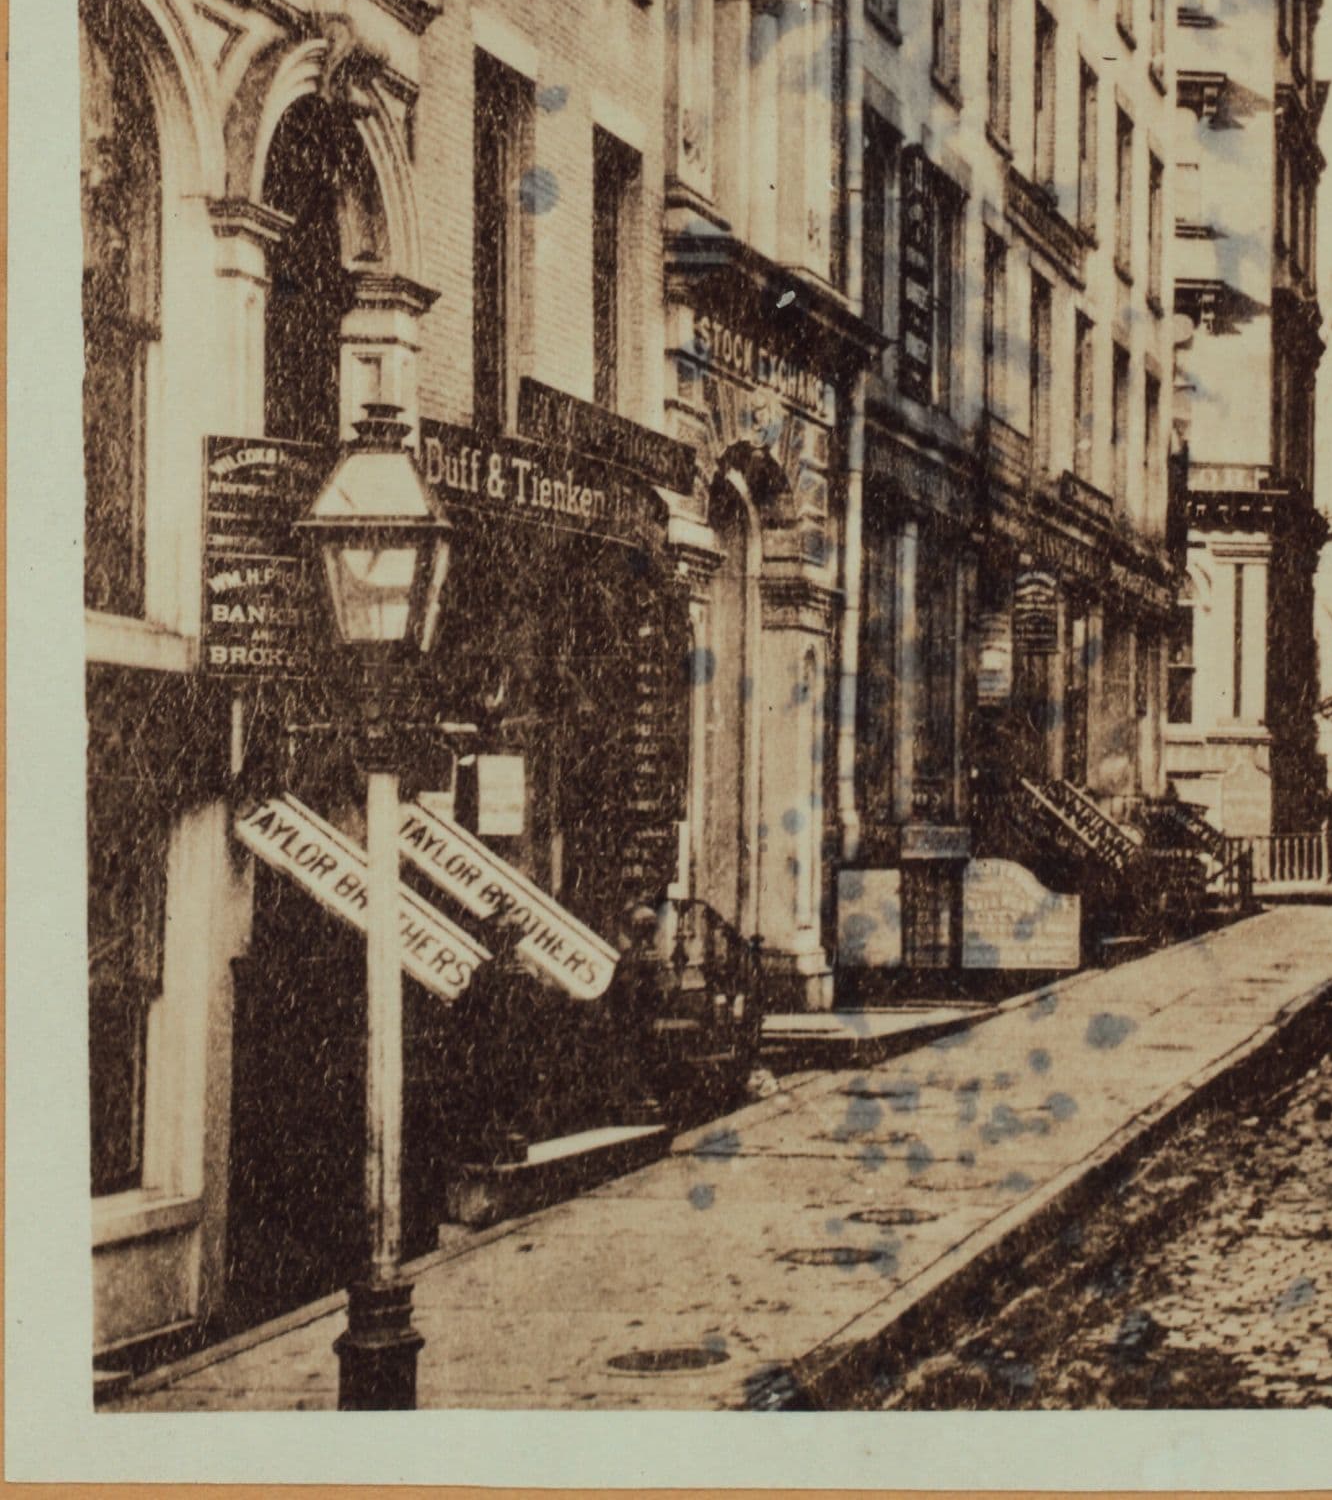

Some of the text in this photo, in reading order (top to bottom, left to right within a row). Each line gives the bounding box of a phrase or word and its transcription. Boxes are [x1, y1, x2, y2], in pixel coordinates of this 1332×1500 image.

[698, 314, 755, 374] STOCK
[424, 436, 481, 494] Duff
[487, 451, 506, 501] &
[512, 456, 606, 520] Tienken
[241, 801, 474, 988] TAYLOR BRHERS
[399, 815, 597, 986] TAYLOR BROTHERS
